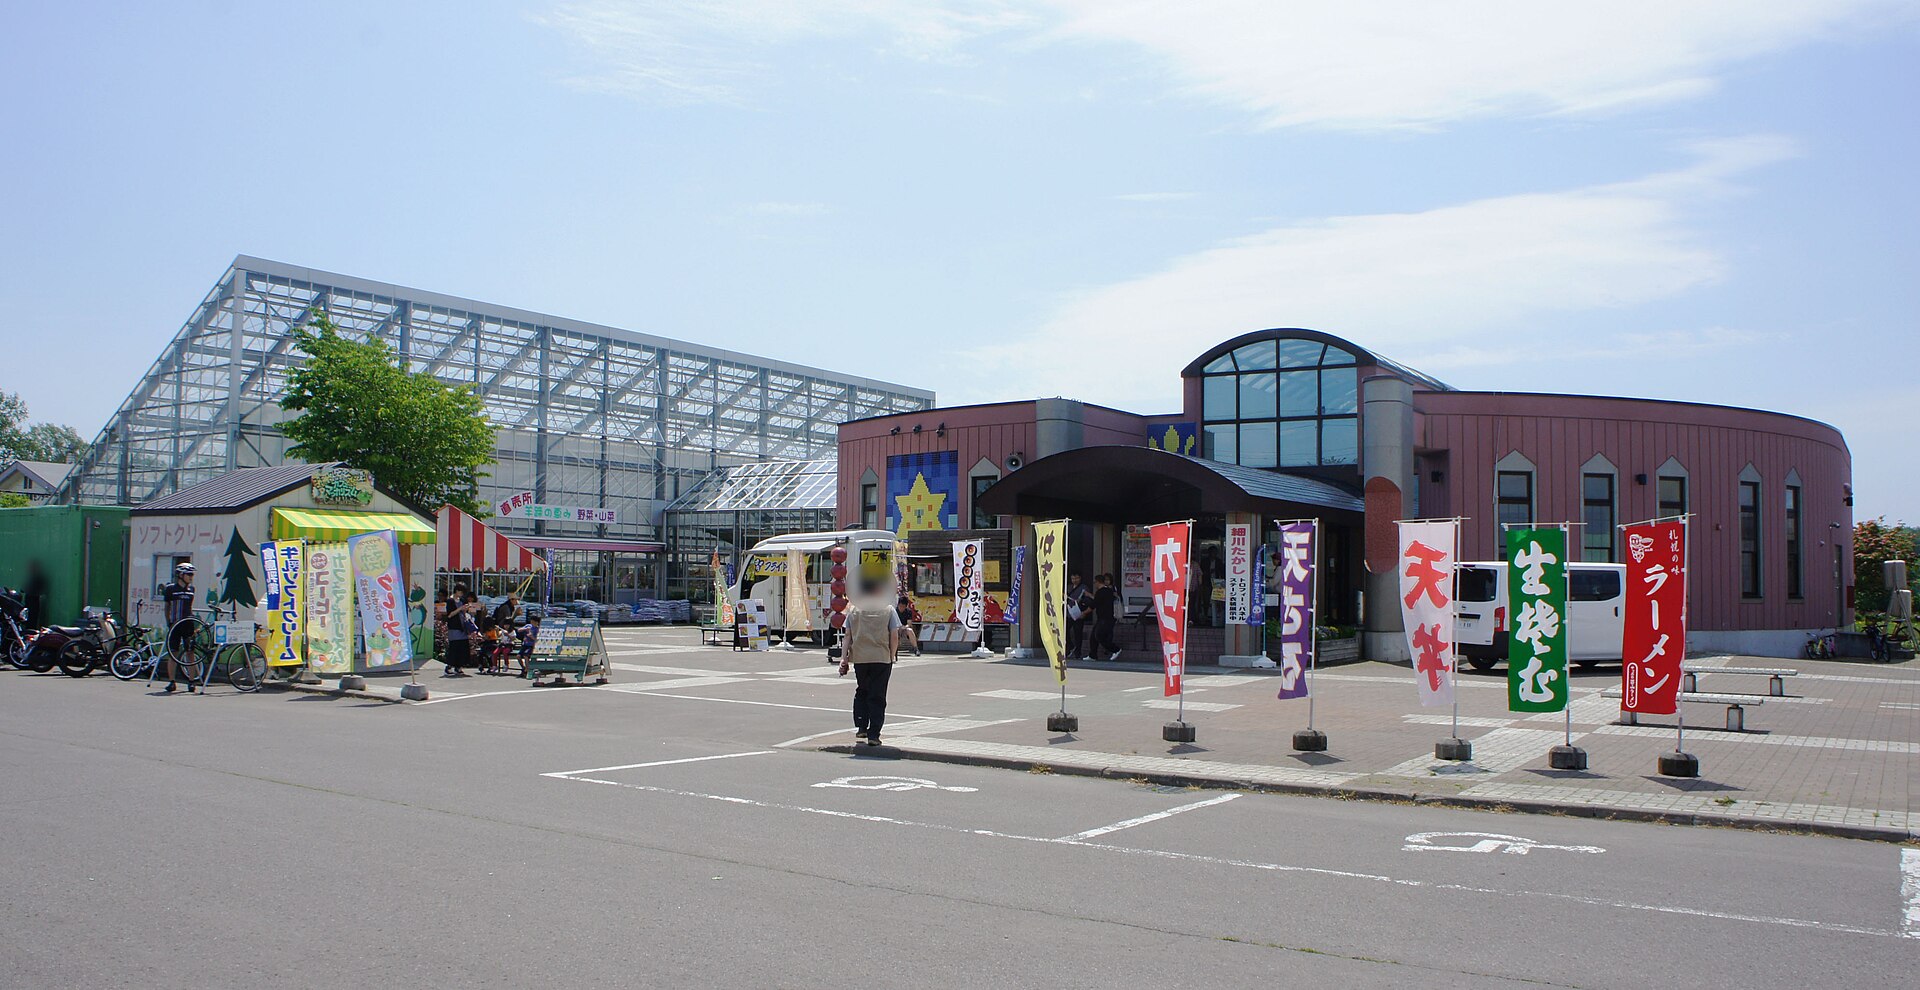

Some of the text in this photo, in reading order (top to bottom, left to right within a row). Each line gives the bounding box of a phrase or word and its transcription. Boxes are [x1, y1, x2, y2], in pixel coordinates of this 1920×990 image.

[499, 491, 533, 516] 直売所
[577, 508, 615, 522] 野菜・山菜
[139, 523, 224, 545] ソフトクリーム
[1230, 527, 1246, 575] 細川たかし
[1642, 563, 1670, 695] ラーメン
